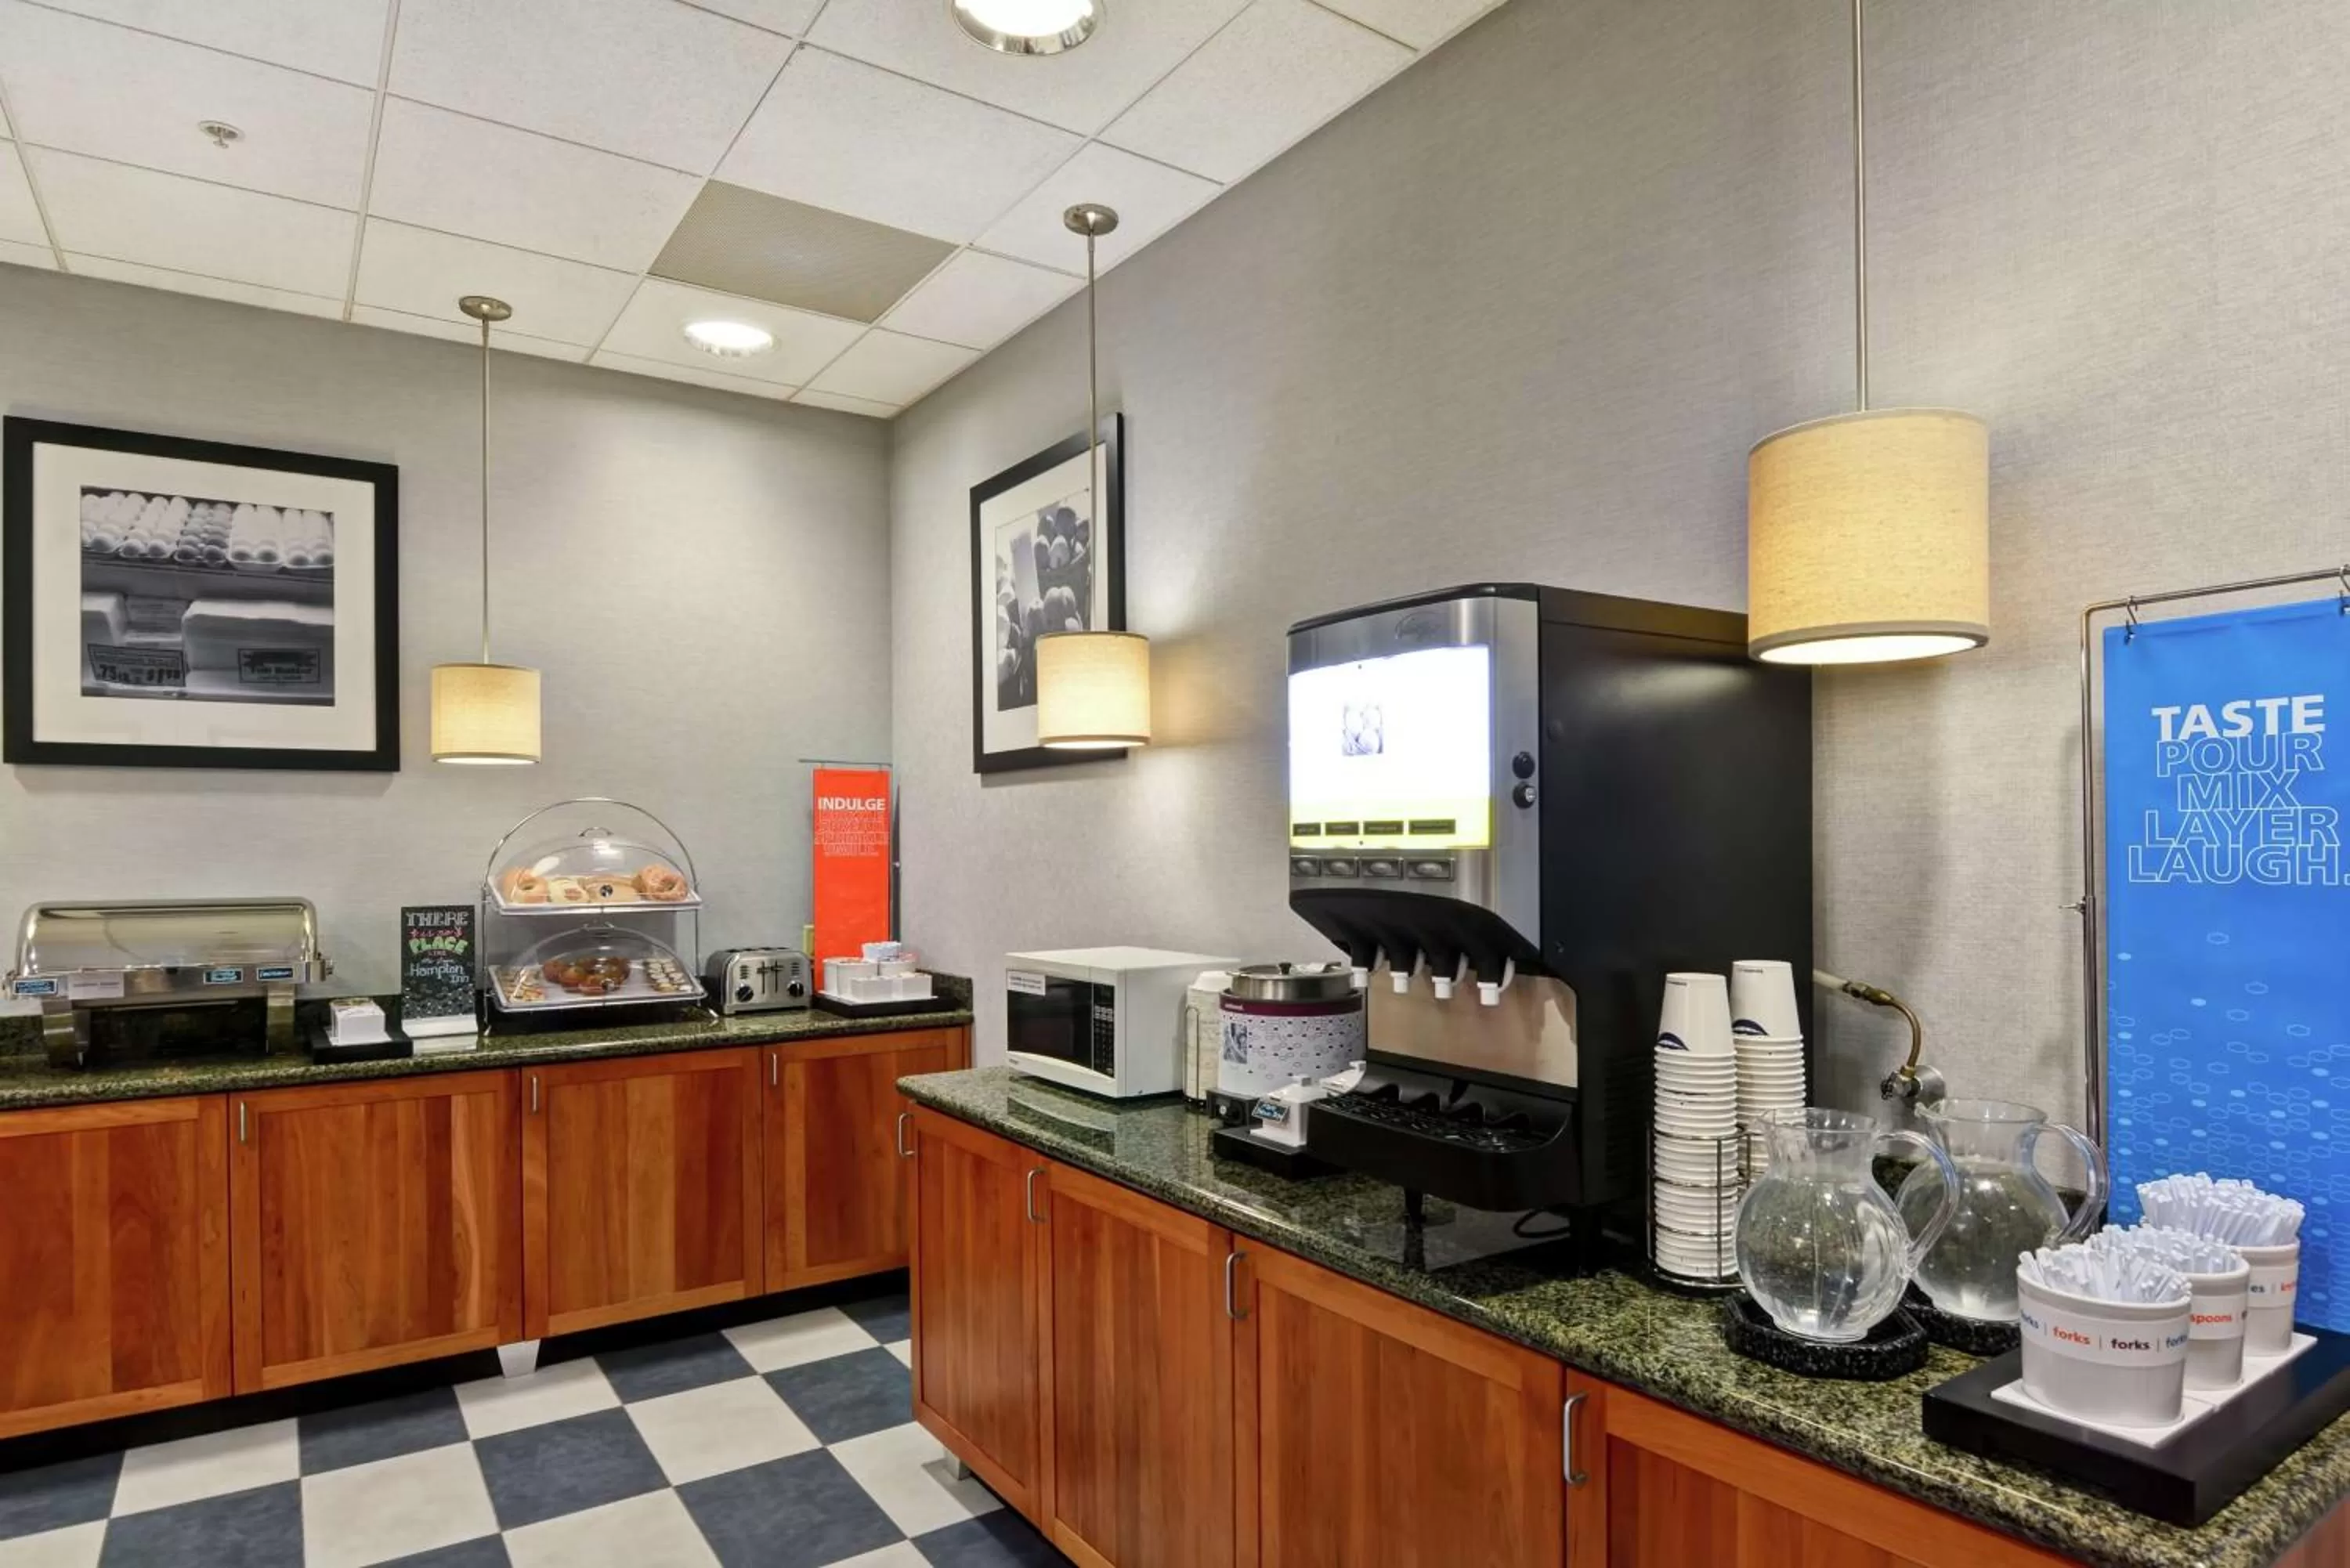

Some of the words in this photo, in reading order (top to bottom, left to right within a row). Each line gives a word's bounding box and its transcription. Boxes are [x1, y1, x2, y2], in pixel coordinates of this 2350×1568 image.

[2151, 695, 2326, 742] TASTE
[2157, 732, 2325, 777] POUR
[818, 797, 886, 811] INDULGE
[2178, 769, 2300, 812] MIX
[2146, 807, 2341, 848] LAYER
[409, 936, 468, 956] PLACE
[410, 963, 465, 979] Hampton
[2053, 1326, 2091, 1346] forks
[2110, 1339, 2150, 1351] forks
